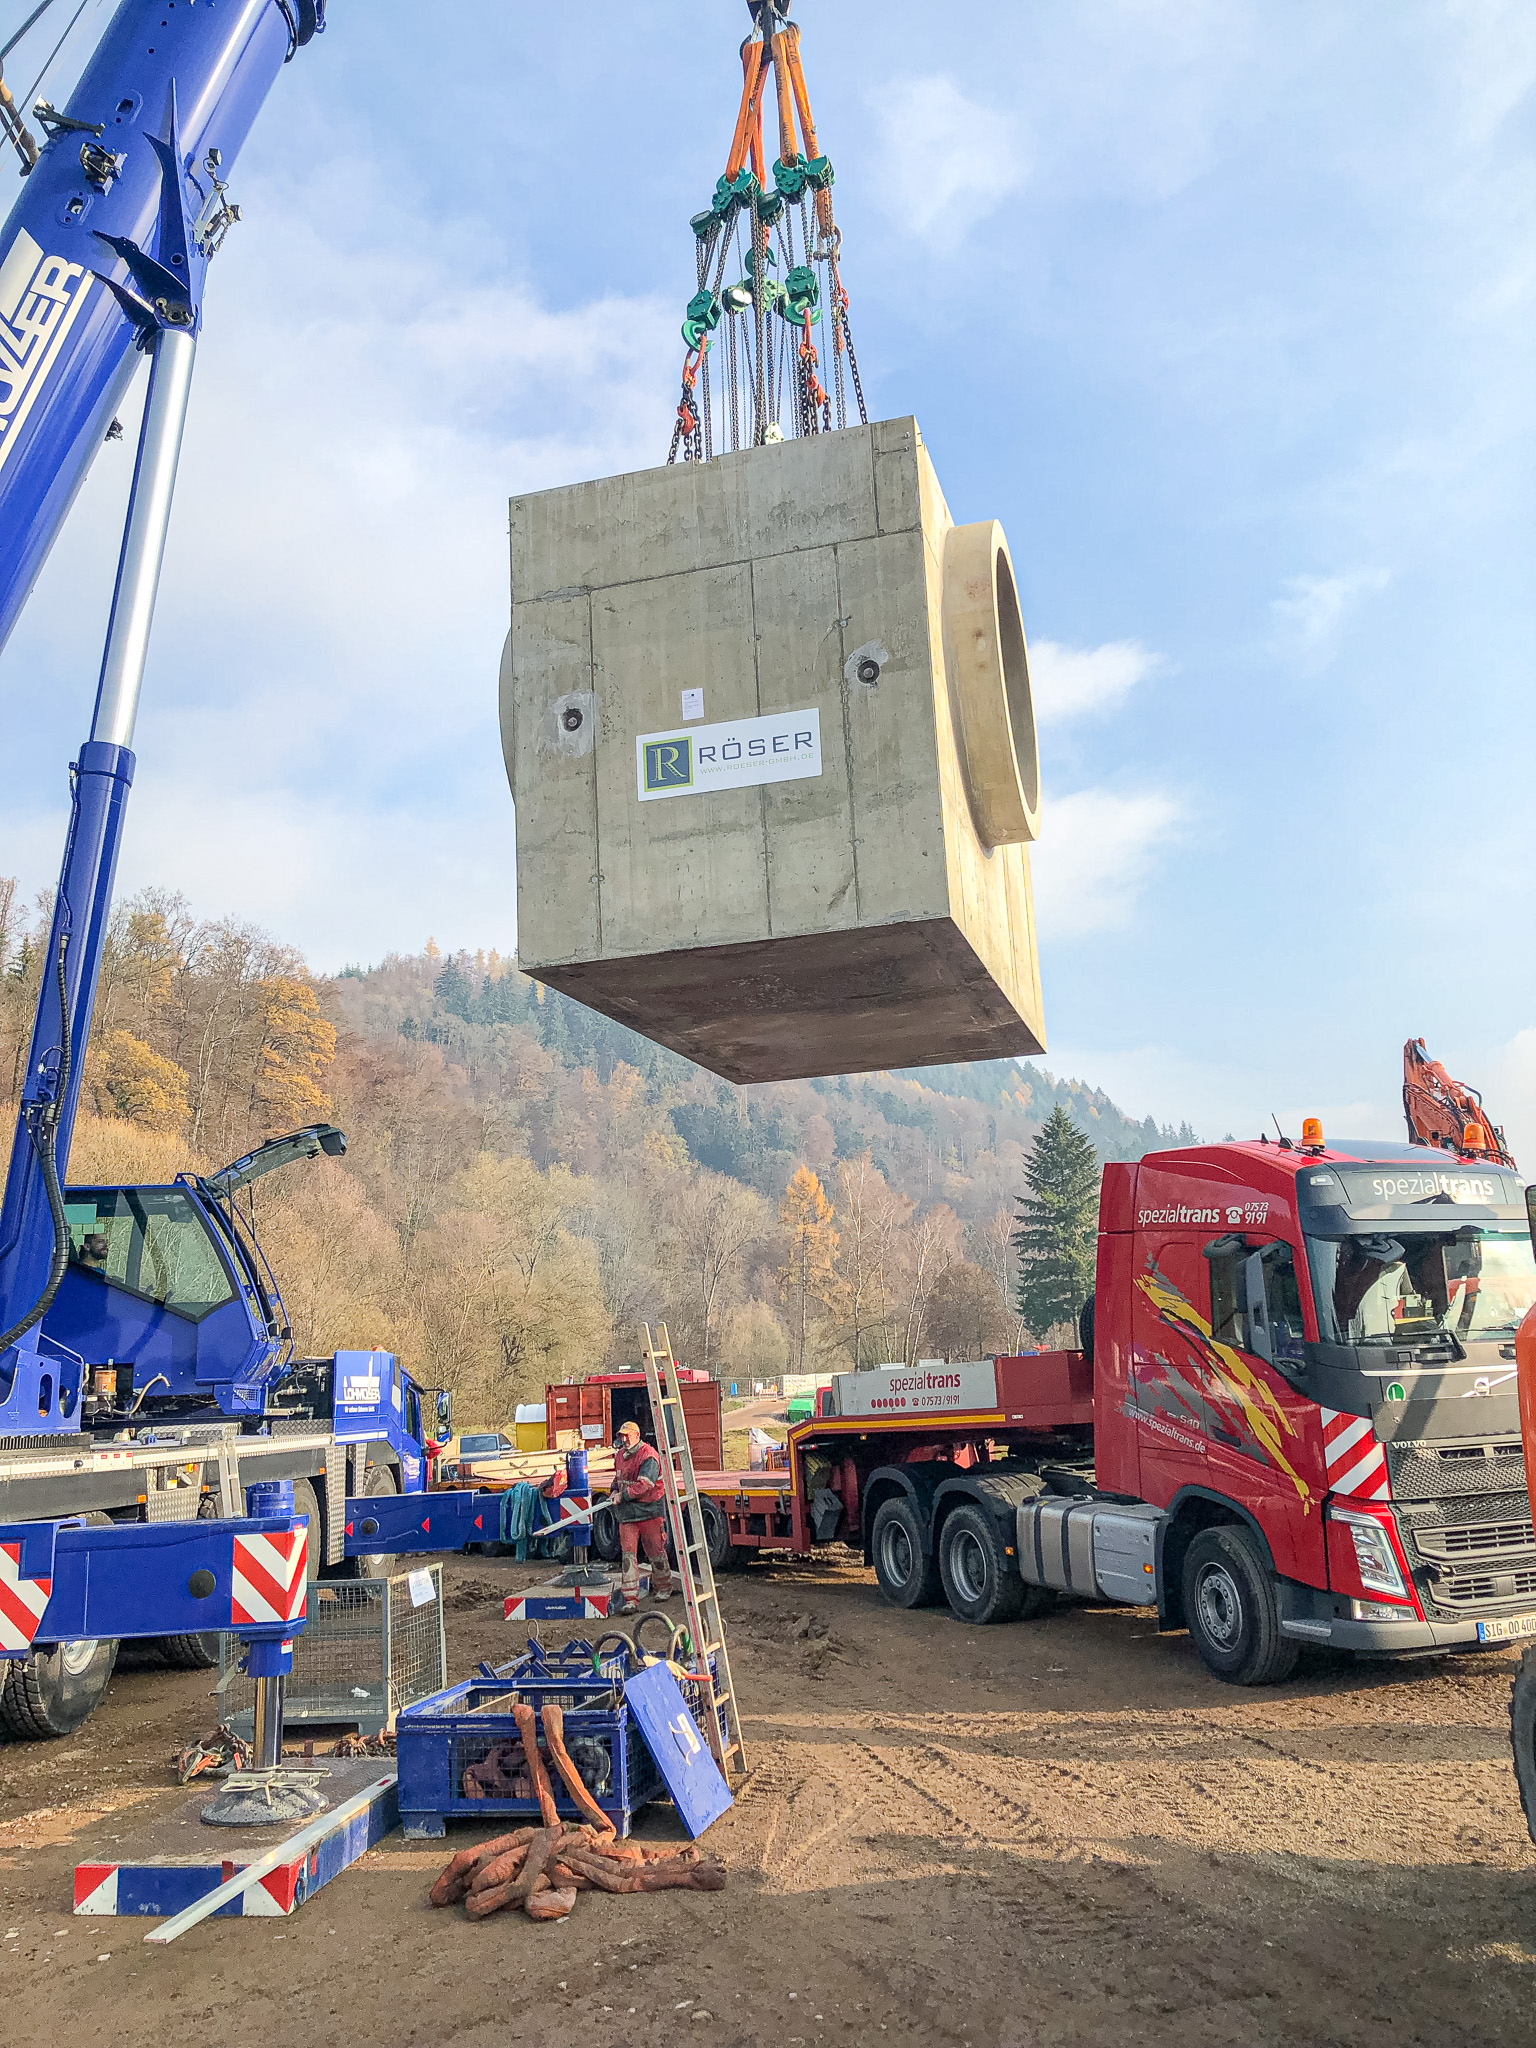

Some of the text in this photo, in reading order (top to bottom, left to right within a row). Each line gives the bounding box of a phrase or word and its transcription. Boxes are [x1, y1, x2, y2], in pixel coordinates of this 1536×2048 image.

[650, 731, 814, 782] R RÖSER
[700, 752, 815, 775] WWW.ROESER-GMBH.DE
[1372, 1171, 1494, 1201] spezialtrans
[1137, 1203, 1221, 1228] spezialtrans
[1244, 1201, 1270, 1212] 07573
[1244, 1211, 1268, 1225] 9191
[889, 1371, 961, 1395] spezialtrans
[1128, 1408, 1207, 1454] www.spezialtrans.de
[1391, 1440, 1427, 1449] VOLVO
[1485, 1622, 1503, 1638] SIG
